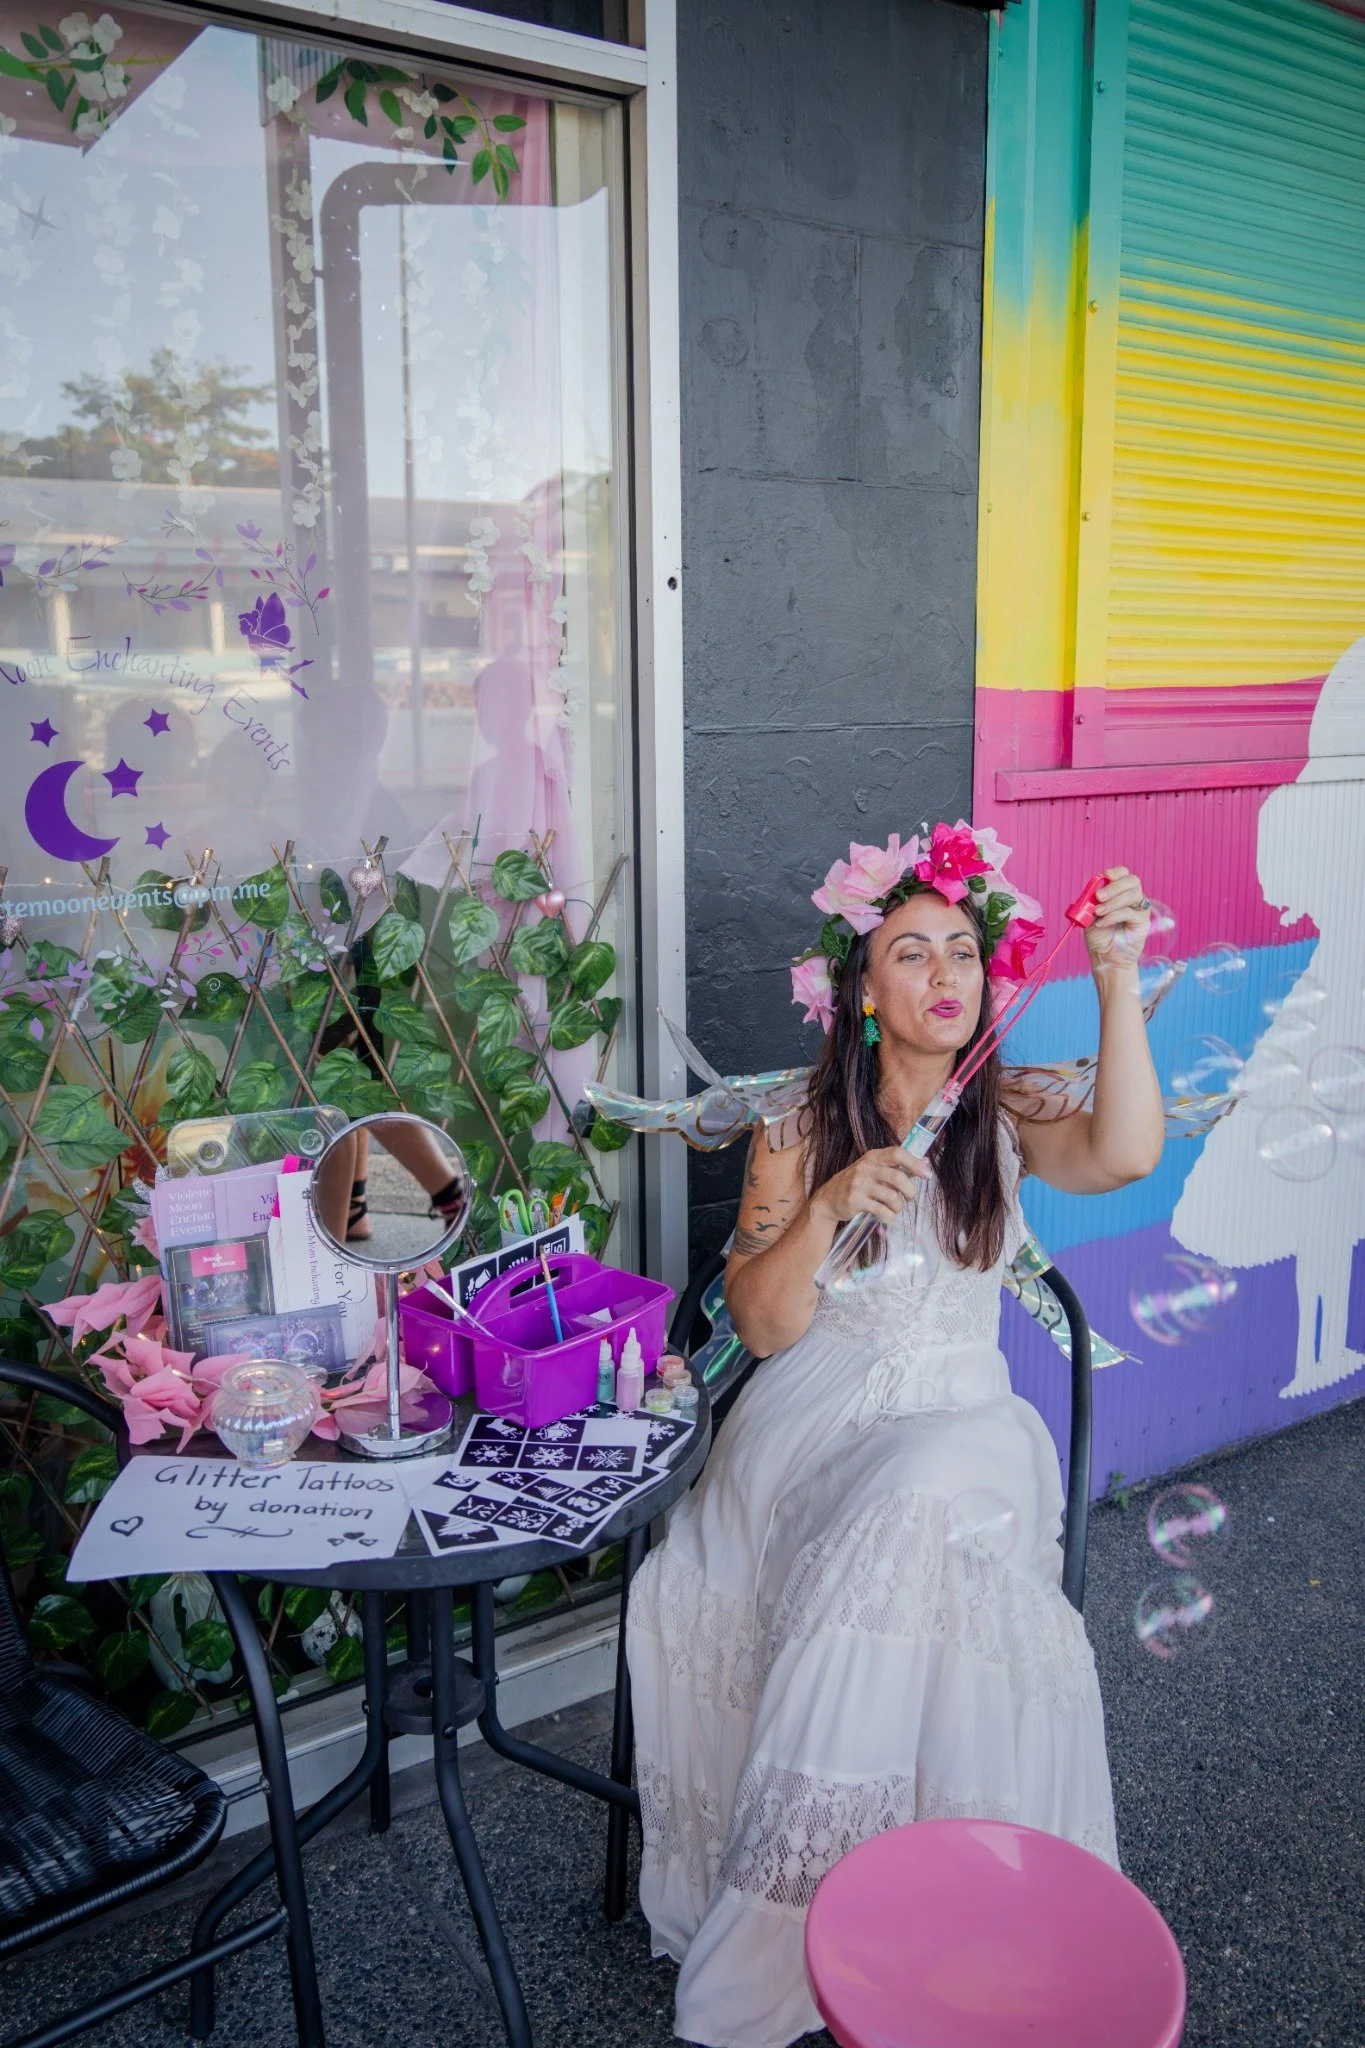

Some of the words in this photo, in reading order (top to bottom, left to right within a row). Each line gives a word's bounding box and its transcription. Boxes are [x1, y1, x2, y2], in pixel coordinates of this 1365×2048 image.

[65, 635, 216, 715] Enchanting
[222, 687, 290, 771] Events
[168, 1188, 213, 1203] Violette
[169, 1201, 202, 1214] Moon
[171, 1223, 212, 1237] Events
[333, 1261, 349, 1286] For
[337, 1289, 353, 1319] You
[154, 1463, 282, 1490] Glitter
[296, 1464, 395, 1493] Tattoos
[194, 1496, 230, 1524] by
[249, 1499, 374, 1521] donation
